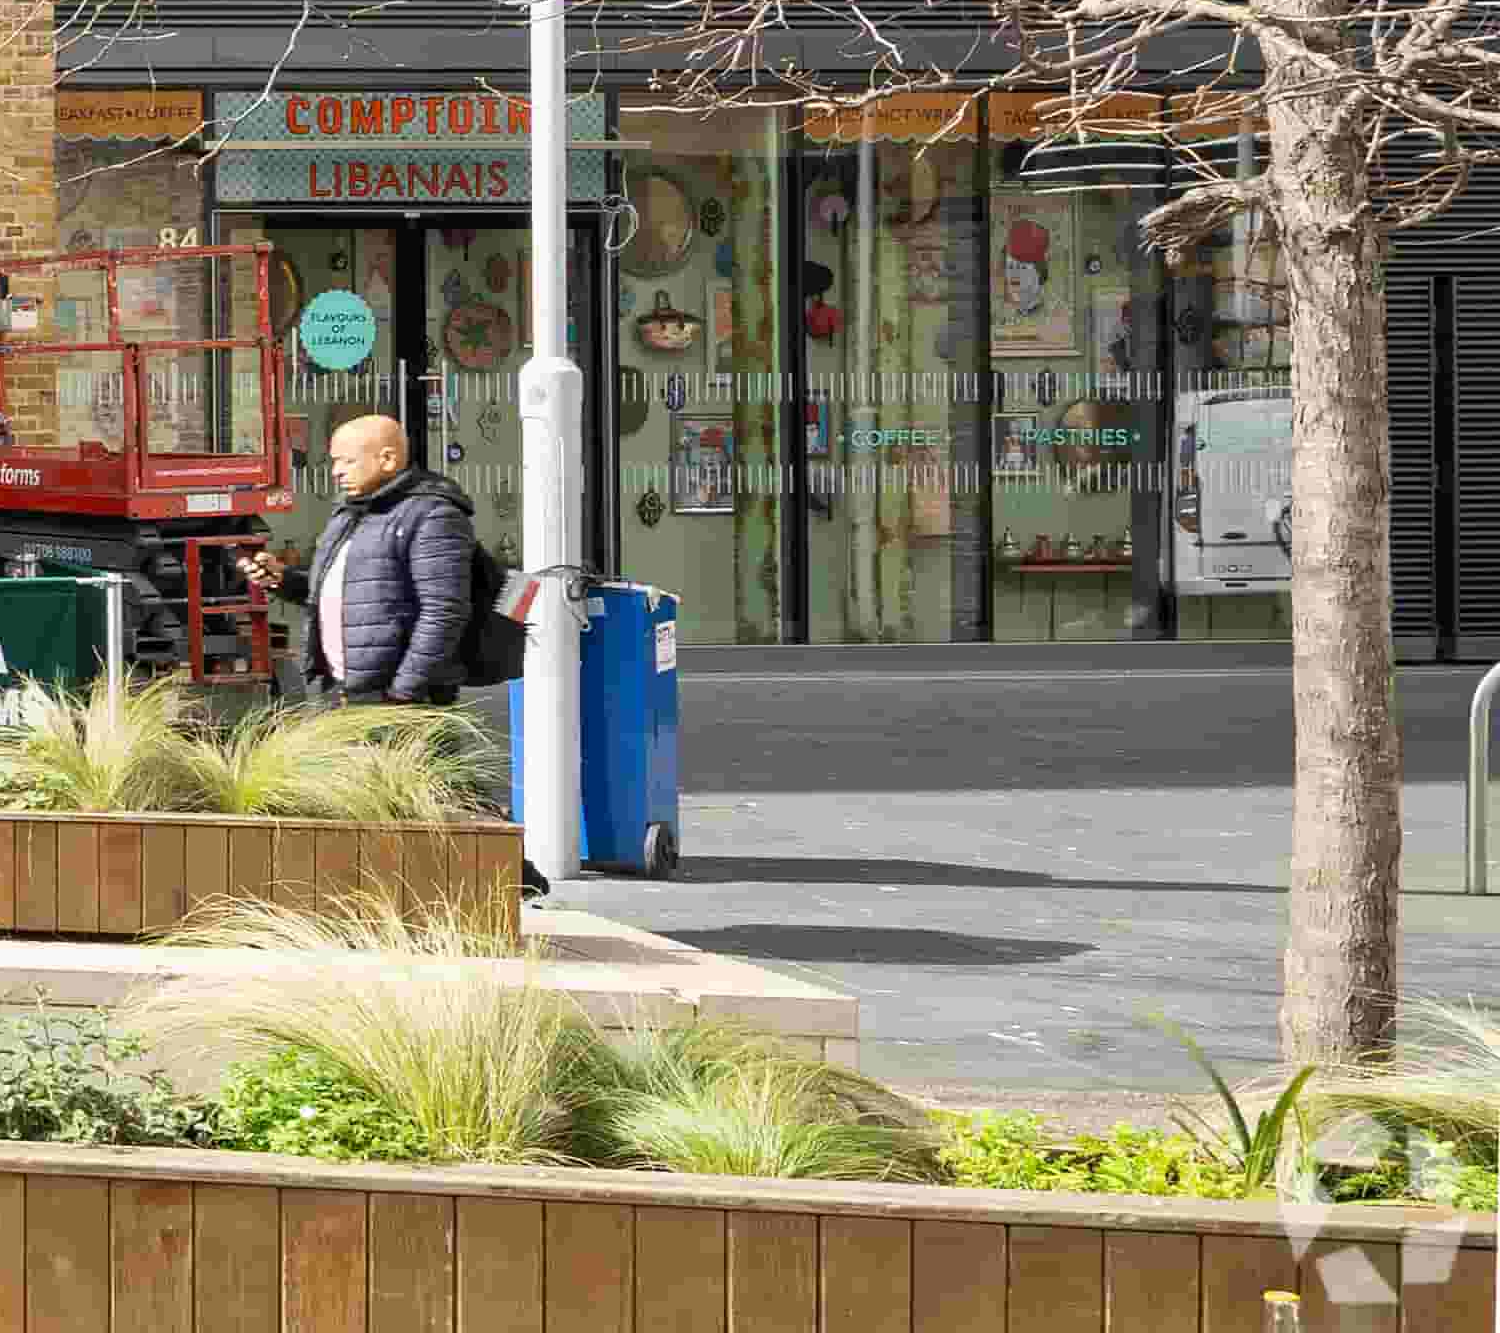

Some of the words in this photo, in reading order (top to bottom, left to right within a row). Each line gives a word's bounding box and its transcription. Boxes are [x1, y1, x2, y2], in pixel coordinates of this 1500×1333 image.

[284, 95, 532, 136] COMPTOIR
[308, 161, 509, 199] LIBANAIS
[158, 227, 197, 248] 84
[851, 429, 938, 446] COFFEE
[1023, 428, 1128, 446] PASTRIES
